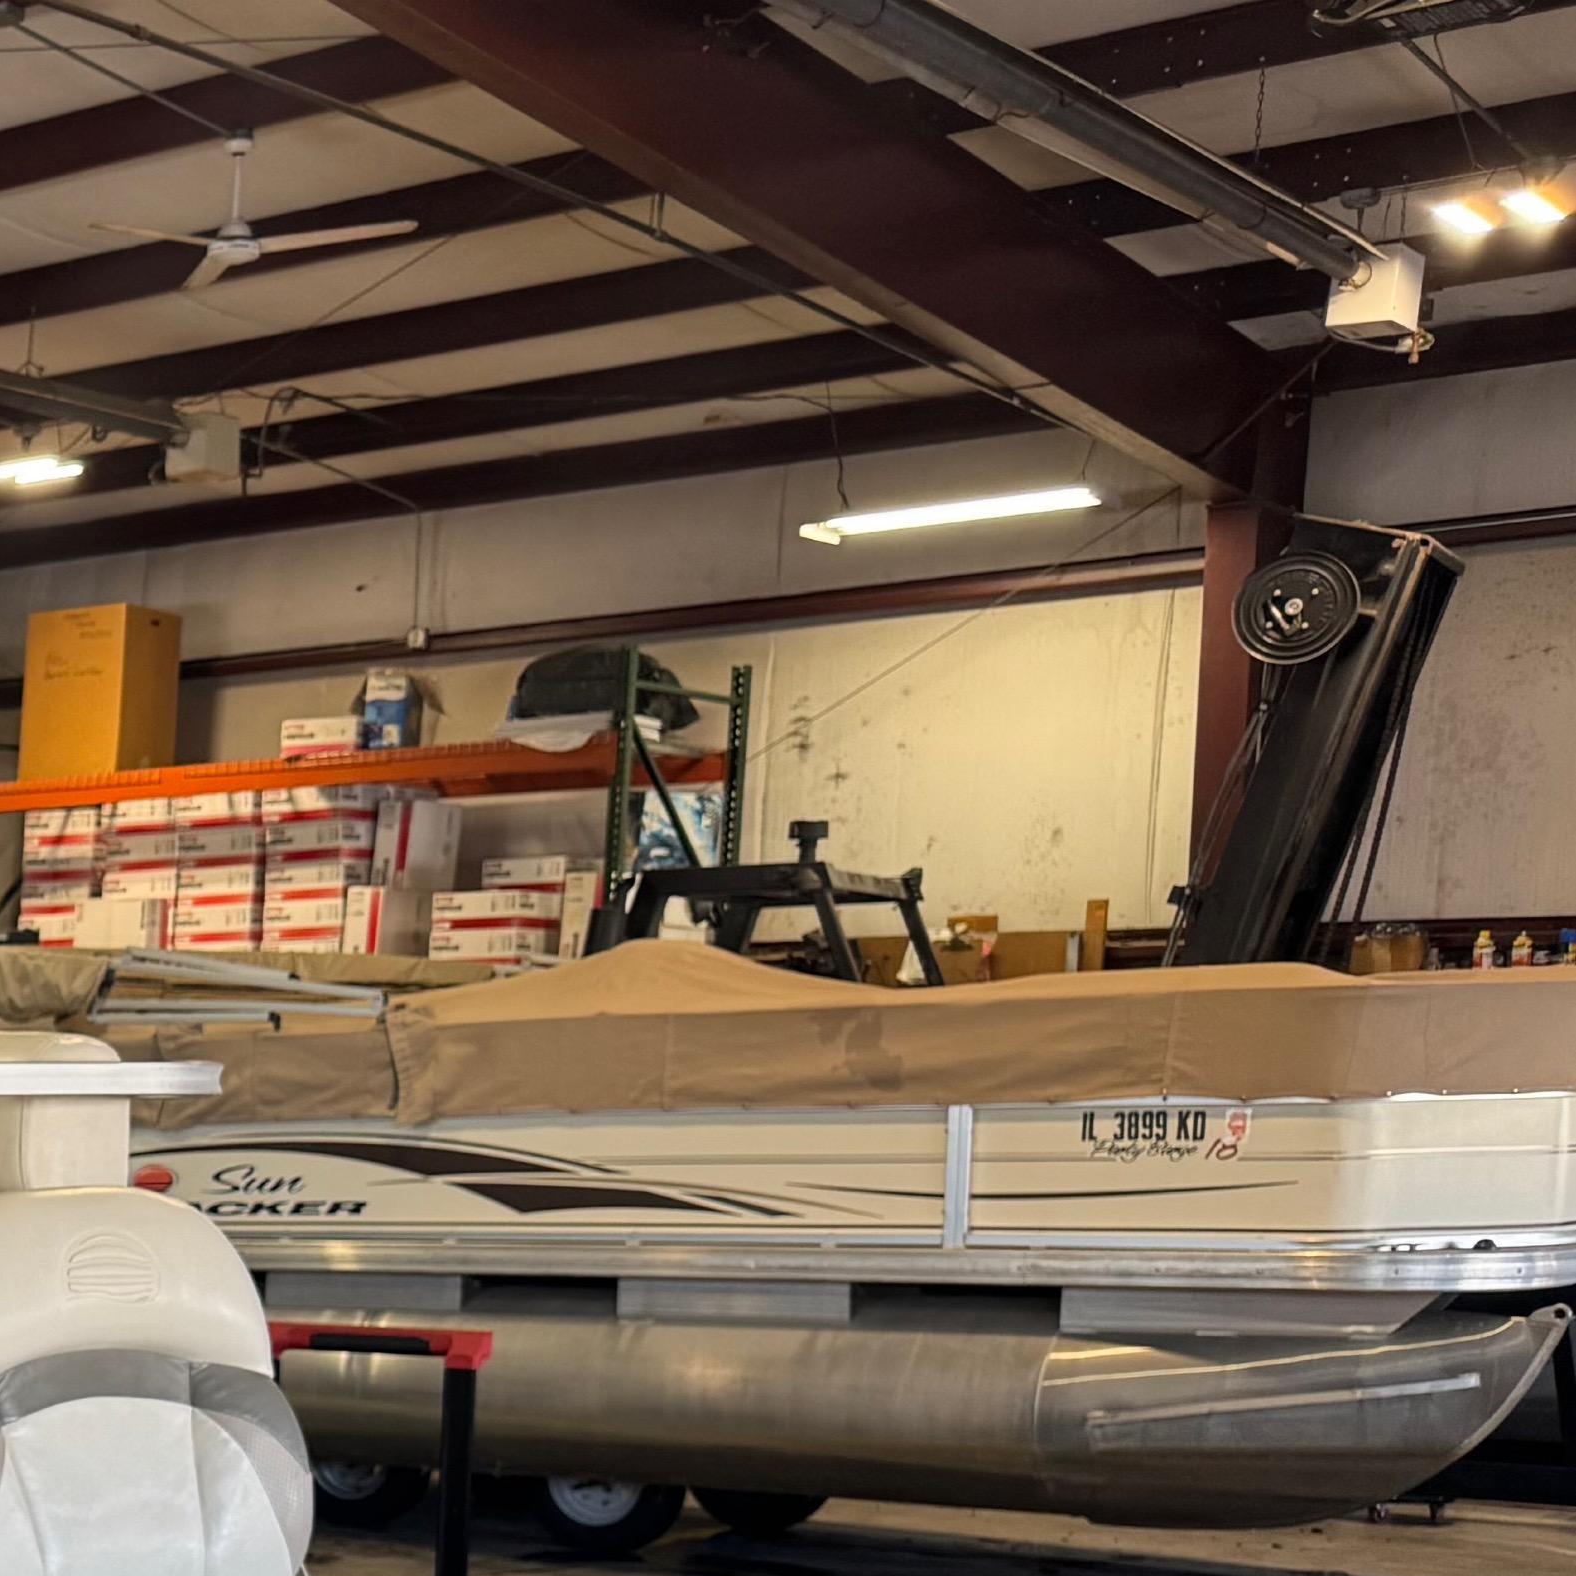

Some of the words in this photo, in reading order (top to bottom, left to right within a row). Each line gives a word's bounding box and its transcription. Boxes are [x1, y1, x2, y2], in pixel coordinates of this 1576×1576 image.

[1081, 1111, 1098, 1142] IL
[1113, 1110, 1168, 1142] 3899
[1176, 1110, 1207, 1142] KD
[200, 1164, 306, 1195] Sun
